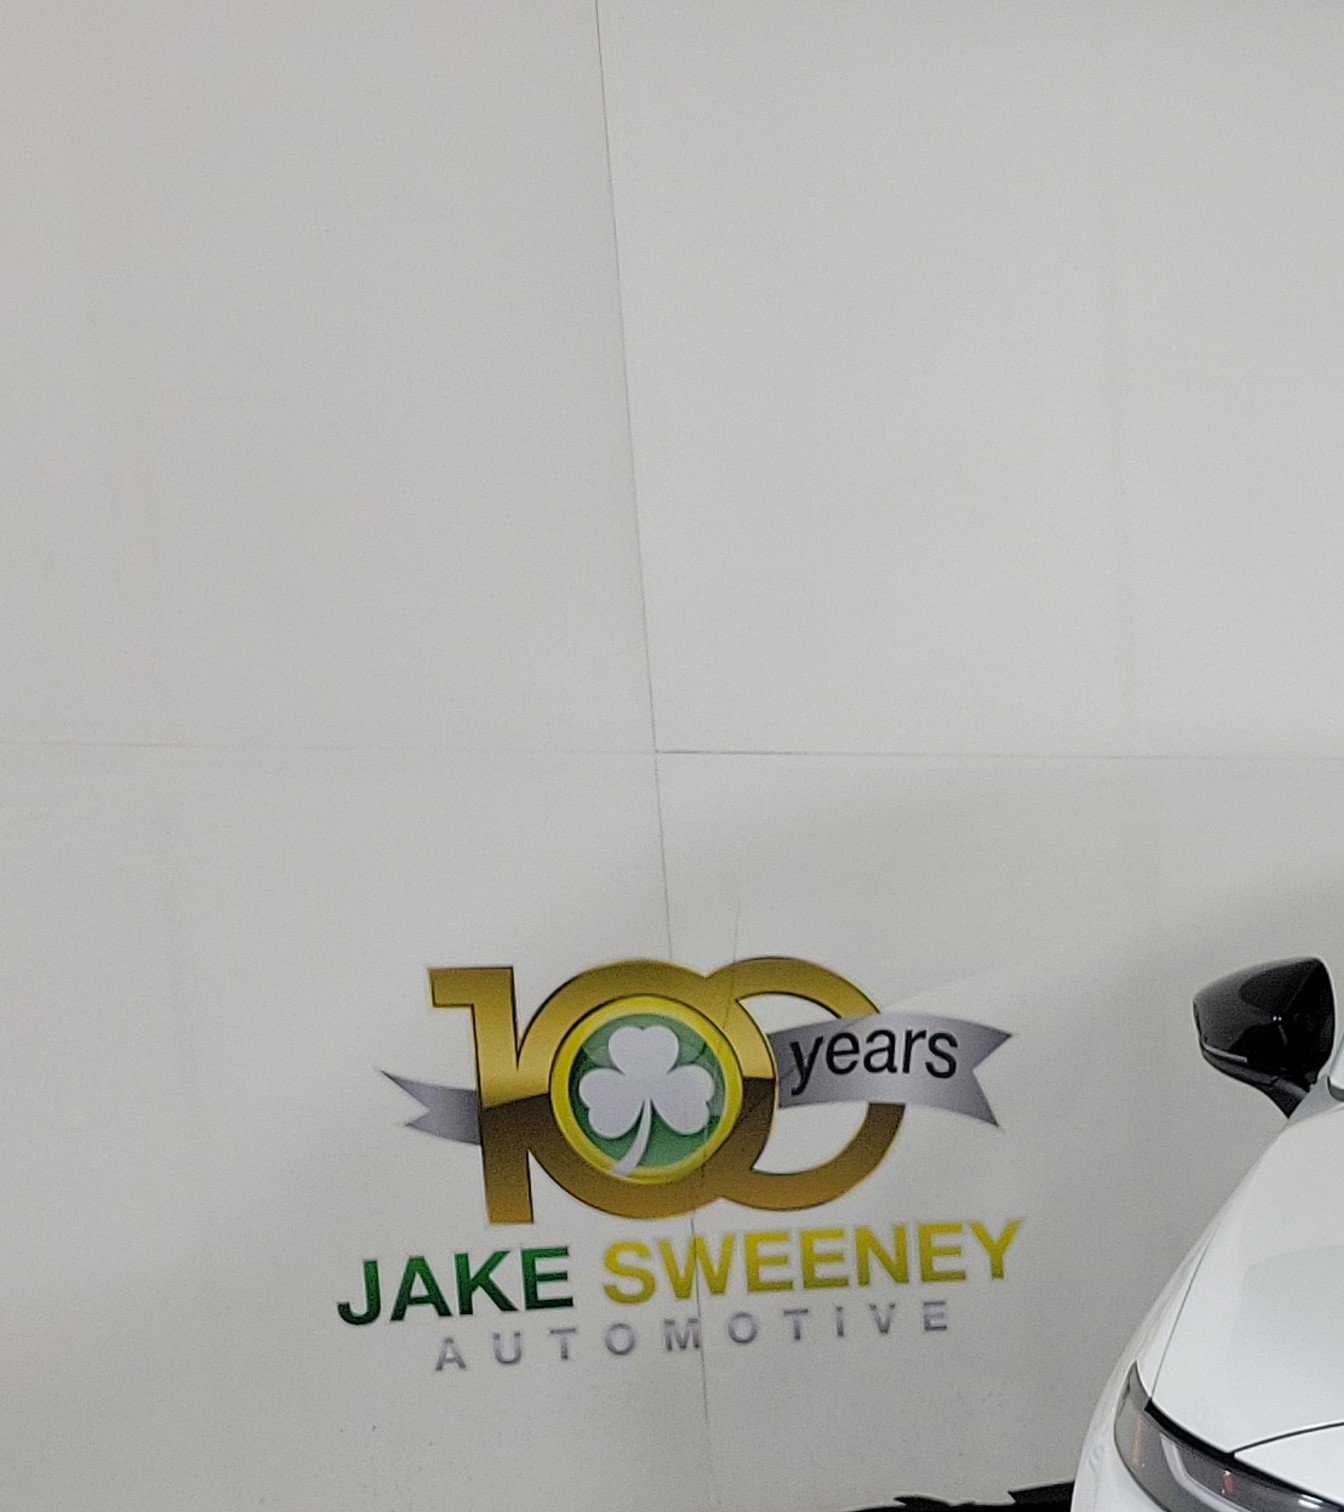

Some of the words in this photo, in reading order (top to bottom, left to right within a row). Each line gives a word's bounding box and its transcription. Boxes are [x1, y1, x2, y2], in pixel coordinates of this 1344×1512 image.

[427, 956, 907, 1225] 100
[788, 1028, 959, 1095] years
[336, 1245, 575, 1327] JAKE
[601, 1219, 1022, 1306] SWEENEY
[434, 1301, 950, 1373] AUTOMOTIVE
